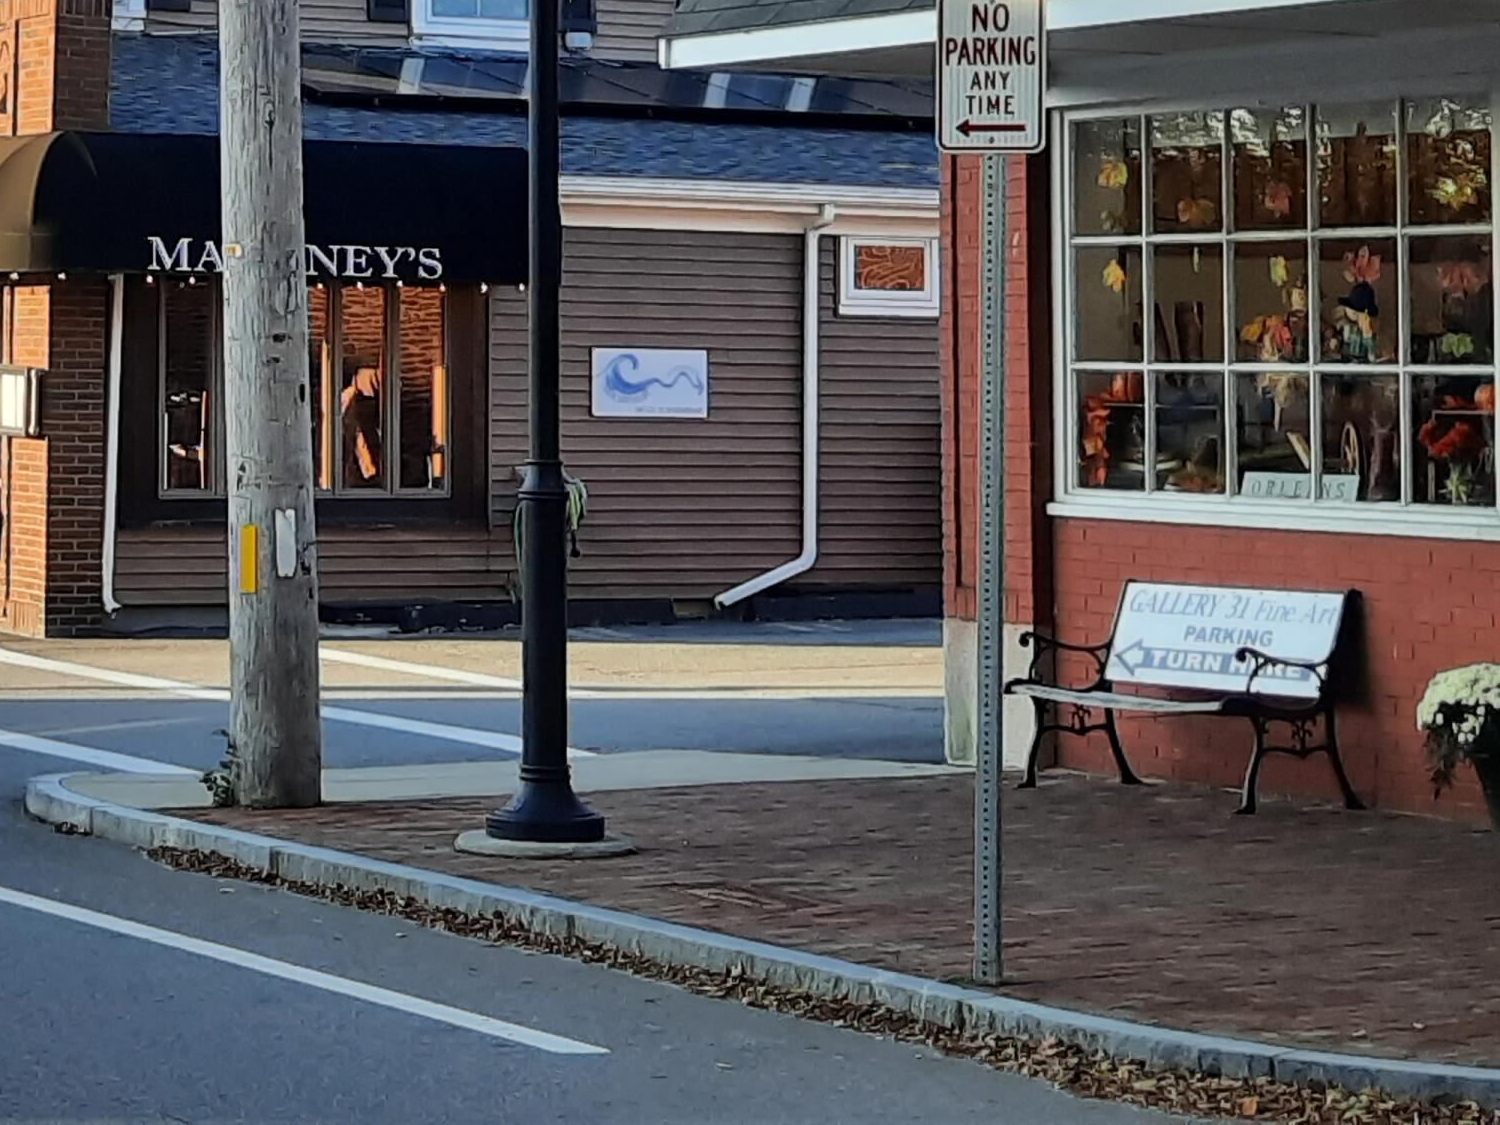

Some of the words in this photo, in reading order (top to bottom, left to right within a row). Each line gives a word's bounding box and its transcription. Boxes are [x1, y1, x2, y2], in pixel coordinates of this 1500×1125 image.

[971, 3, 1010, 33] NO
[945, 35, 1036, 67] PARKING
[969, 71, 1011, 91] ANY
[965, 95, 1016, 116] TIME
[147, 236, 443, 279] MANEY'S
[1251, 479, 1346, 500] ORLENS
[1129, 589, 1222, 618] GALLERY
[1224, 594, 1252, 619] 31
[1253, 599, 1297, 623] Fine
[1300, 602, 1339, 625] Art
[1183, 625, 1274, 647] PARKING
[1150, 650, 1223, 673] TURN
